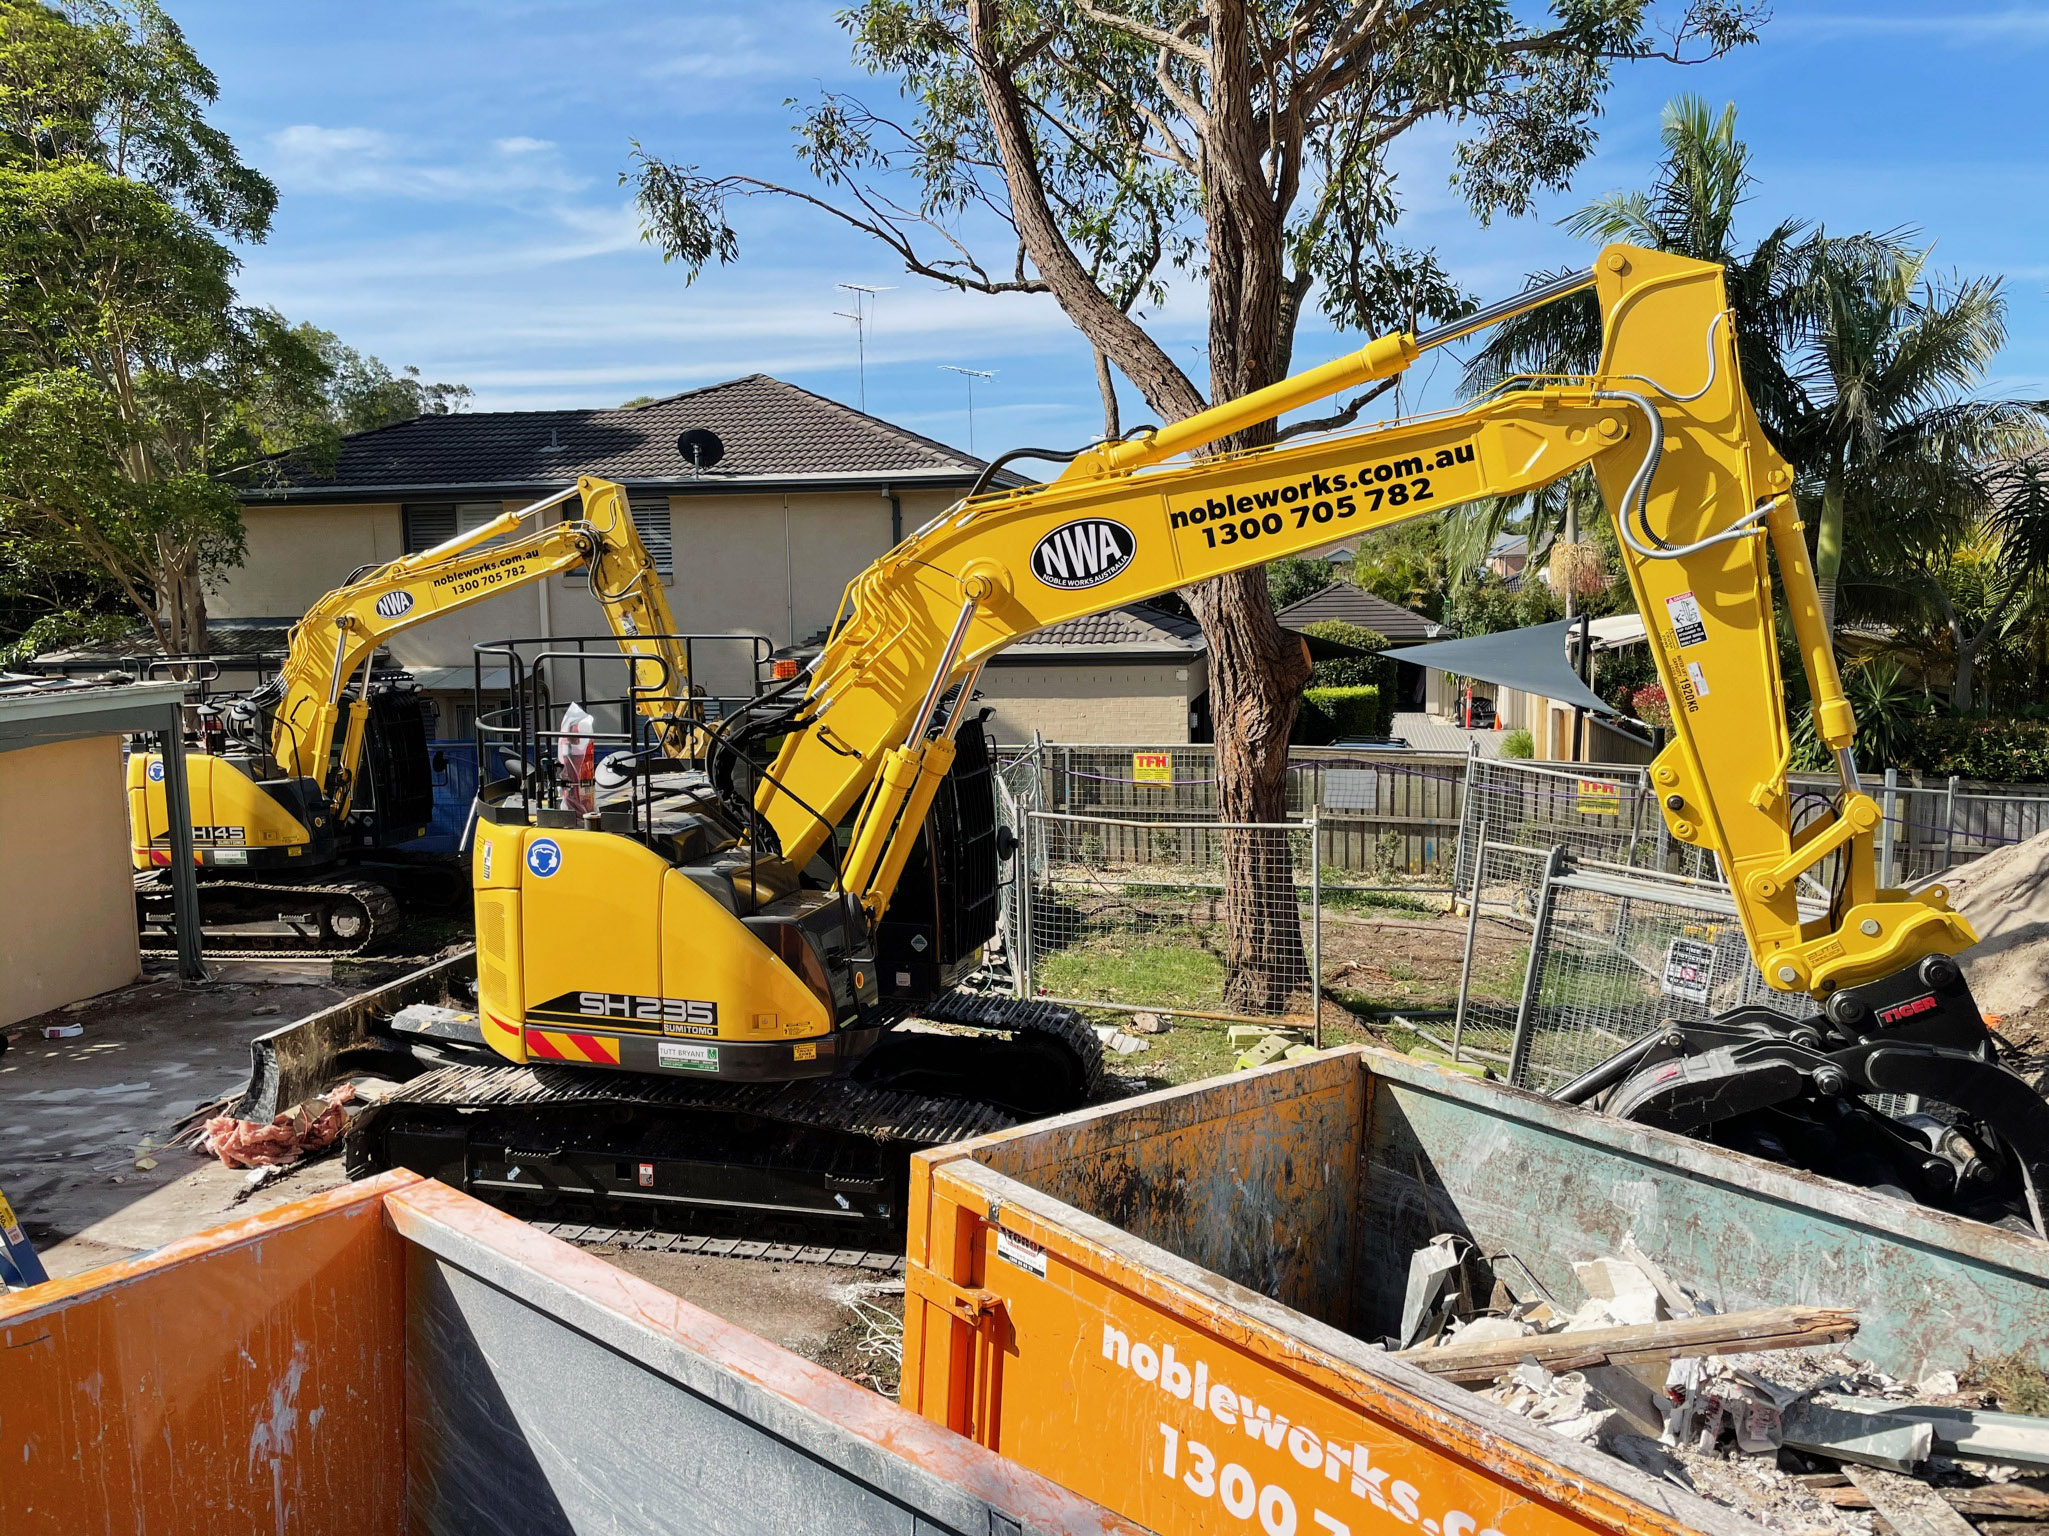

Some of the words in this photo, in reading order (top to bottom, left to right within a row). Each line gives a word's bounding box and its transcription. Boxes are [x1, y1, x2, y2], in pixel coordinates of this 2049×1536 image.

[1170, 443, 1476, 530] nobleworks.com.au
[1201, 511, 1283, 549] 1300
[1290, 495, 1358, 529] 705
[1364, 478, 1434, 512] 782
[1040, 523, 1122, 579] NWA
[433, 548, 540, 588] nobleworks.com.au
[452, 581, 480, 596] 1300
[481, 573, 503, 586] 705
[504, 565, 527, 579] 782
[1042, 573, 1067, 587] NOBLE
[1067, 577, 1095, 587] WORKS
[1094, 554, 1130, 583] AUSTRALIA
[378, 591, 411, 617] NWA
[1680, 678, 1699, 713] 1920KG
[1136, 755, 1167, 768] TFH
[579, 992, 630, 1018] SH
[636, 996, 713, 1025] 235
[1880, 996, 1937, 1024] TIGER
[663, 1023, 714, 1036] SUMITOMO
[660, 1048, 677, 1056] TUTT
[678, 1049, 705, 1058] BRYANT
[1159, 1421, 1298, 1536] 1300
